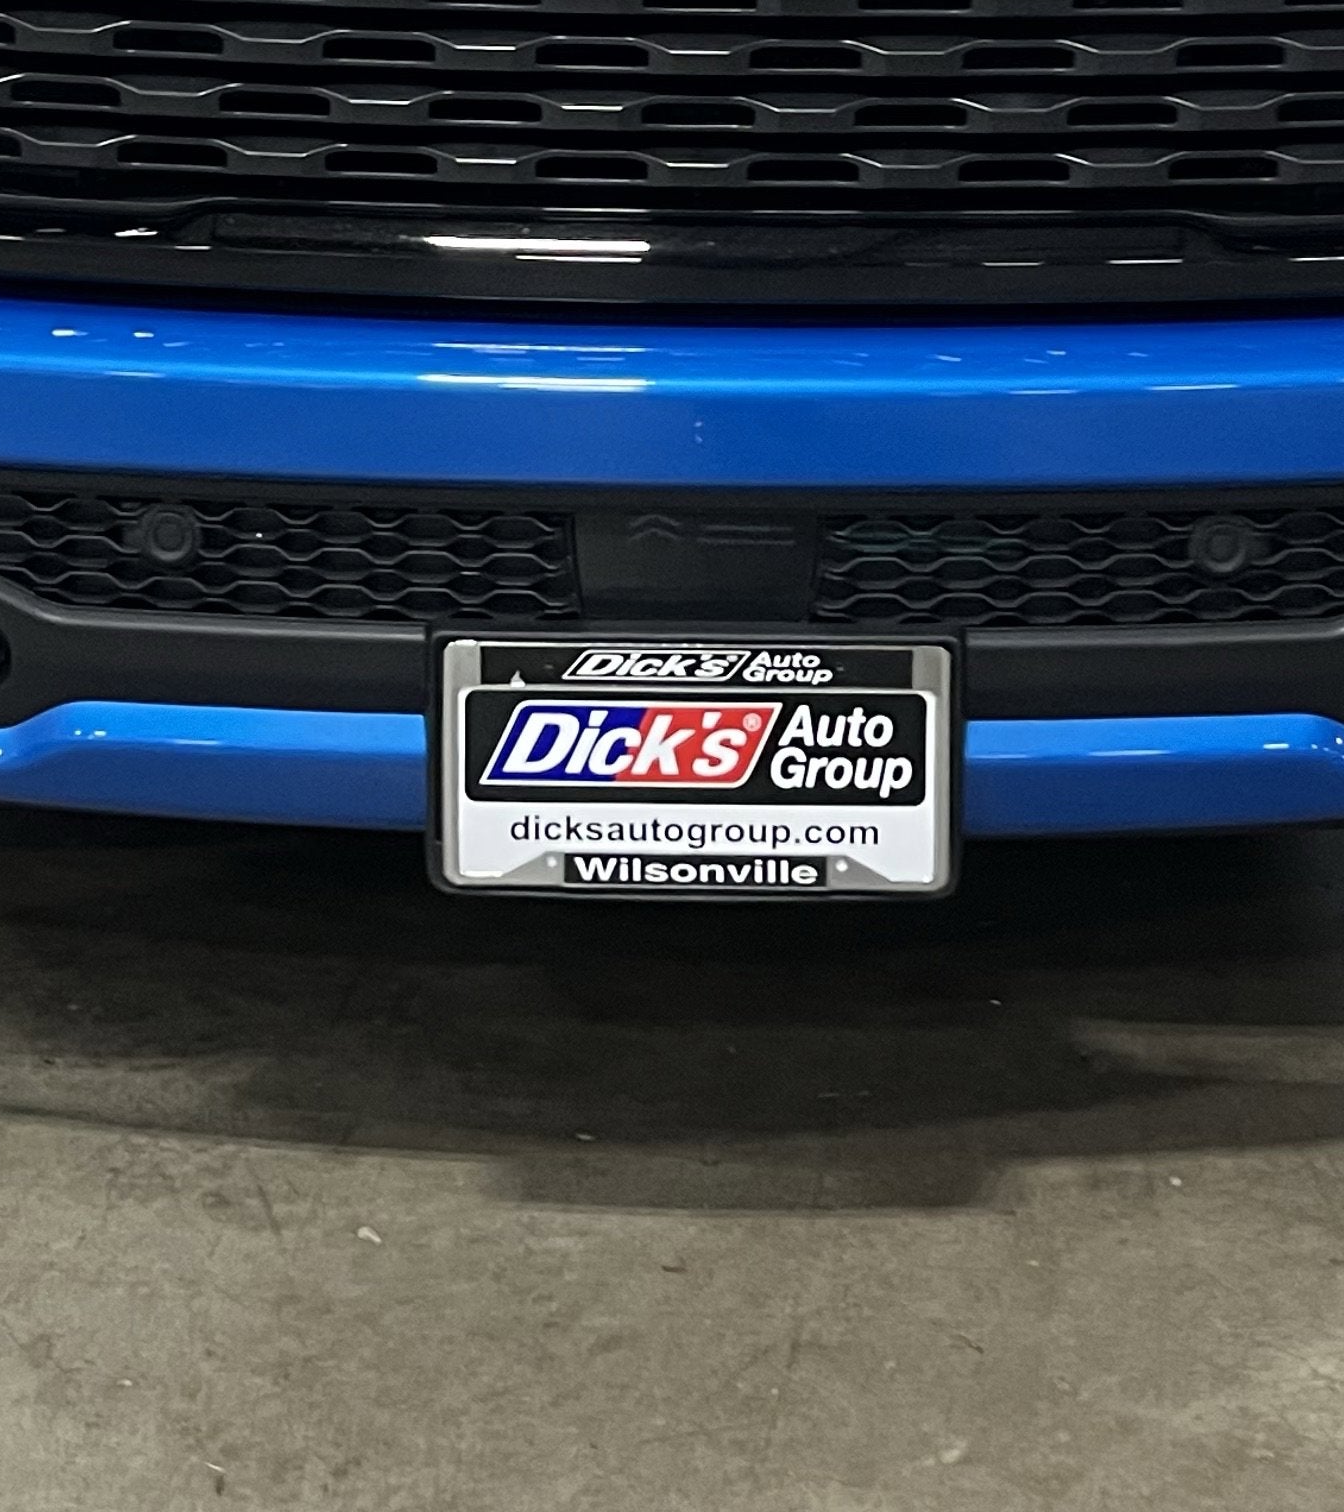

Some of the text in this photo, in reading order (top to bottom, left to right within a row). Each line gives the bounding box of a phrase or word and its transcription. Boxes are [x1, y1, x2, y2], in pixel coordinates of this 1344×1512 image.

[577, 652, 732, 678] Dick's
[744, 665, 833, 685] Group
[756, 651, 820, 669] Auto
[780, 704, 894, 748] Auto
[502, 709, 748, 777] Dick's
[770, 746, 913, 798] Group
[510, 816, 879, 849] dicksautogroup.com
[574, 857, 818, 885] Wilsonville
